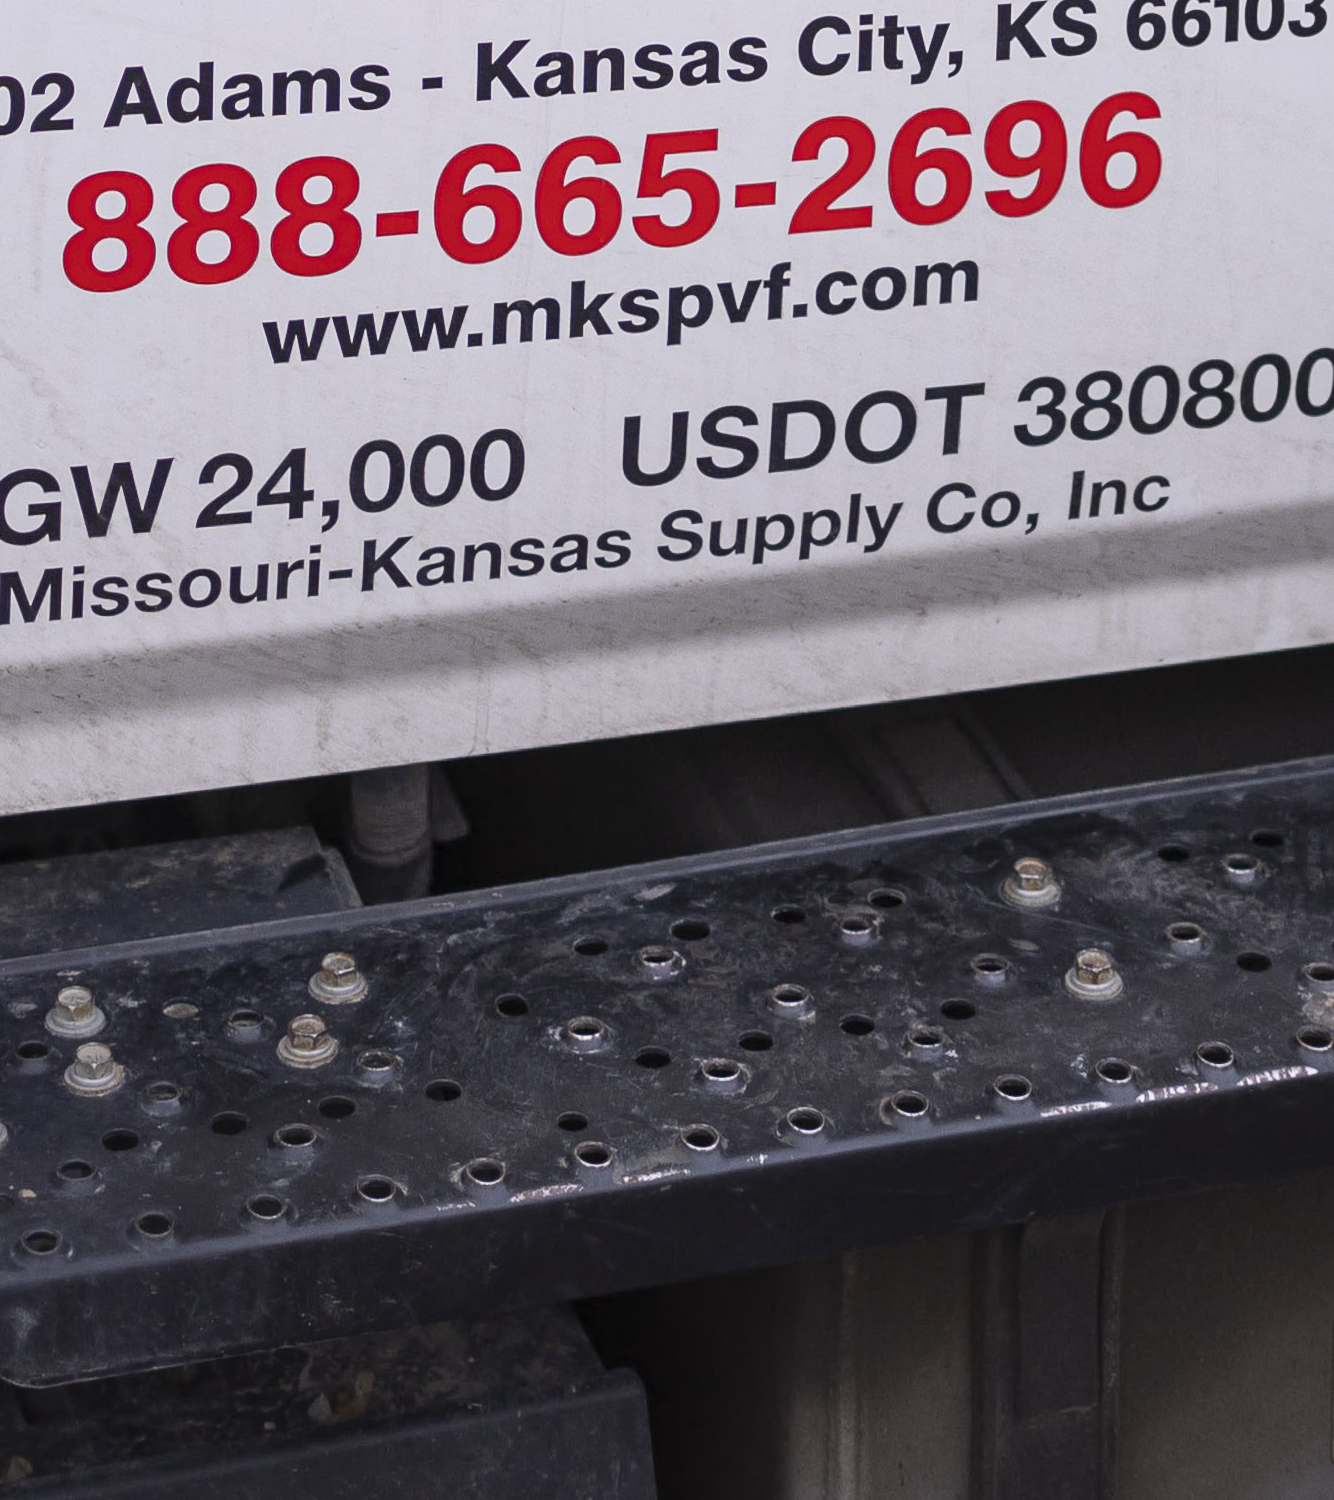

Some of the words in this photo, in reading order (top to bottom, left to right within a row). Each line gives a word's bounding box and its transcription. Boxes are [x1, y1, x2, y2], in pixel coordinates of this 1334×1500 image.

[103, 61, 391, 128] Adams
[476, 37, 768, 102] Kansas
[798, 13, 963, 85] City,
[63, 91, 1162, 292] 888-665-2696
[262, 260, 979, 364] www.mkspvf.com
[195, 428, 525, 533] 24,000
[622, 382, 986, 487] USDOT
[657, 493, 904, 565] Supply
[926, 482, 1039, 535] Co,
[1068, 470, 1170, 520] Inc
